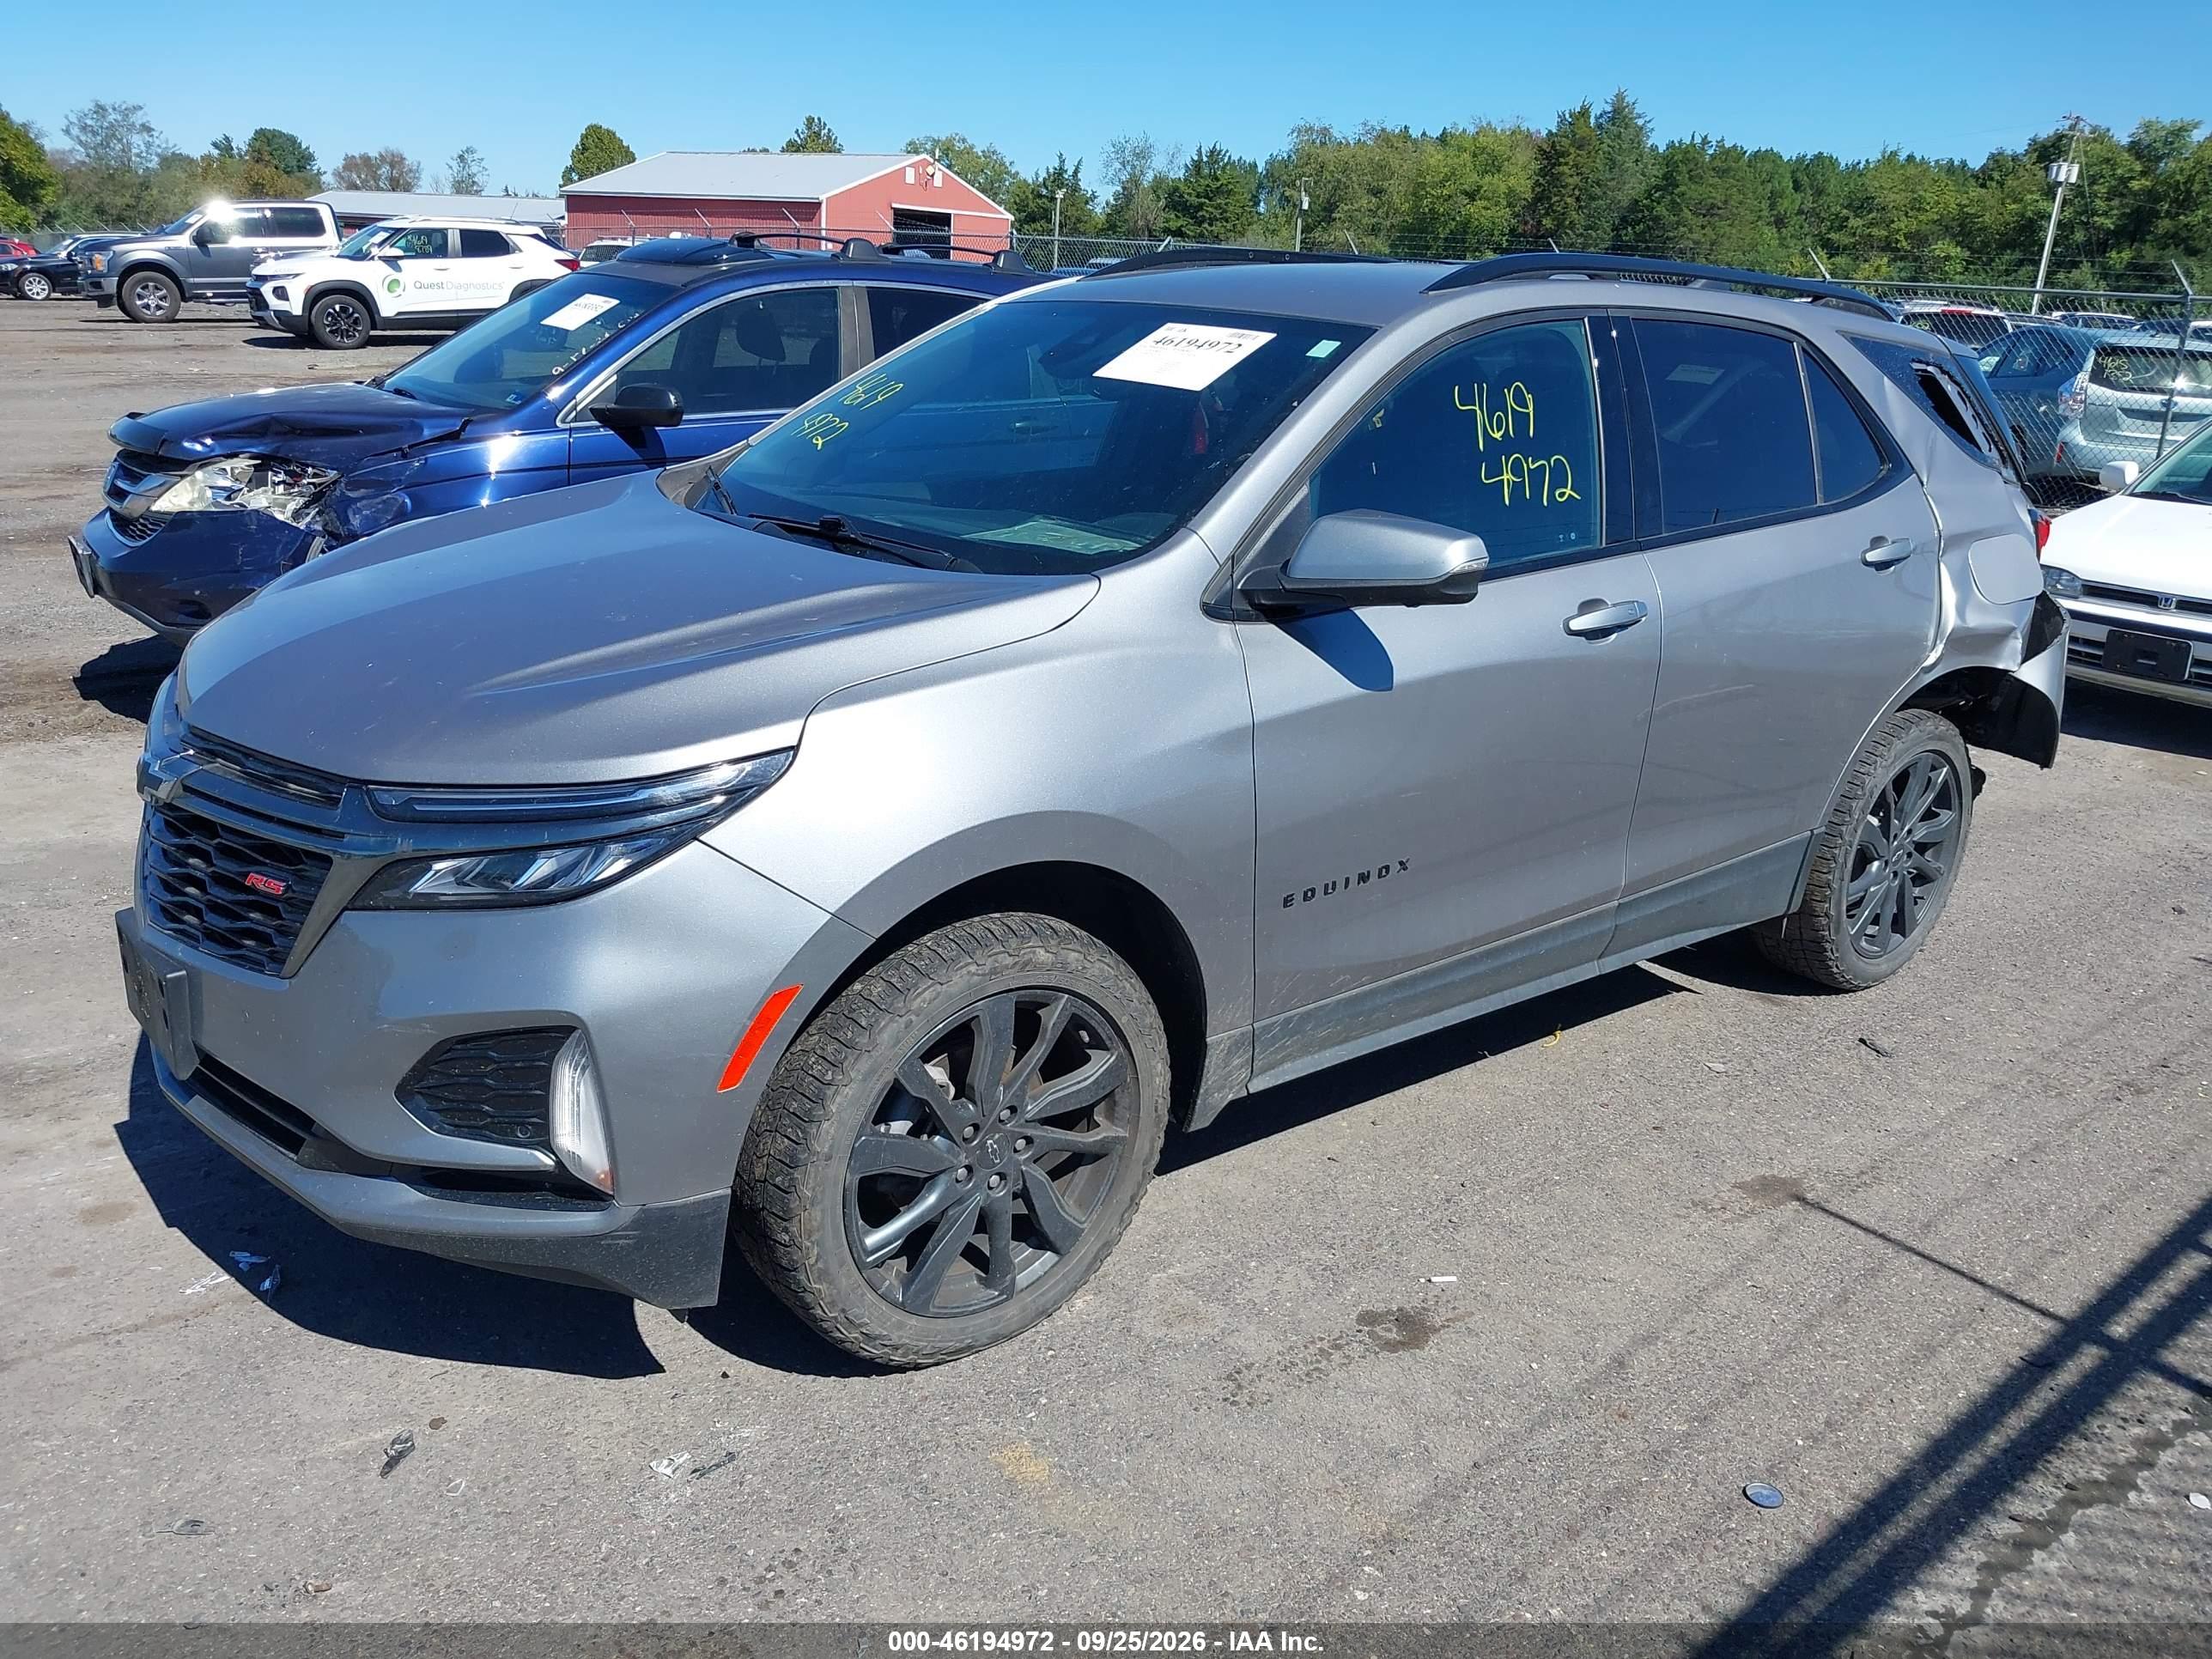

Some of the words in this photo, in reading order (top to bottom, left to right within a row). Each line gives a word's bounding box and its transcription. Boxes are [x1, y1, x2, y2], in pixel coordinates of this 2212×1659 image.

[414, 280, 445, 290] Quest
[446, 280, 503, 292] Diagnostics
[1153, 335, 1243, 354] 46194972
[838, 373, 904, 410] 4619
[790, 412, 849, 450] 4972
[1455, 381, 1534, 452] 4619
[1481, 453, 1582, 507] 4972
[245, 872, 287, 895] RS
[1282, 857, 1411, 909] EQUINOX
